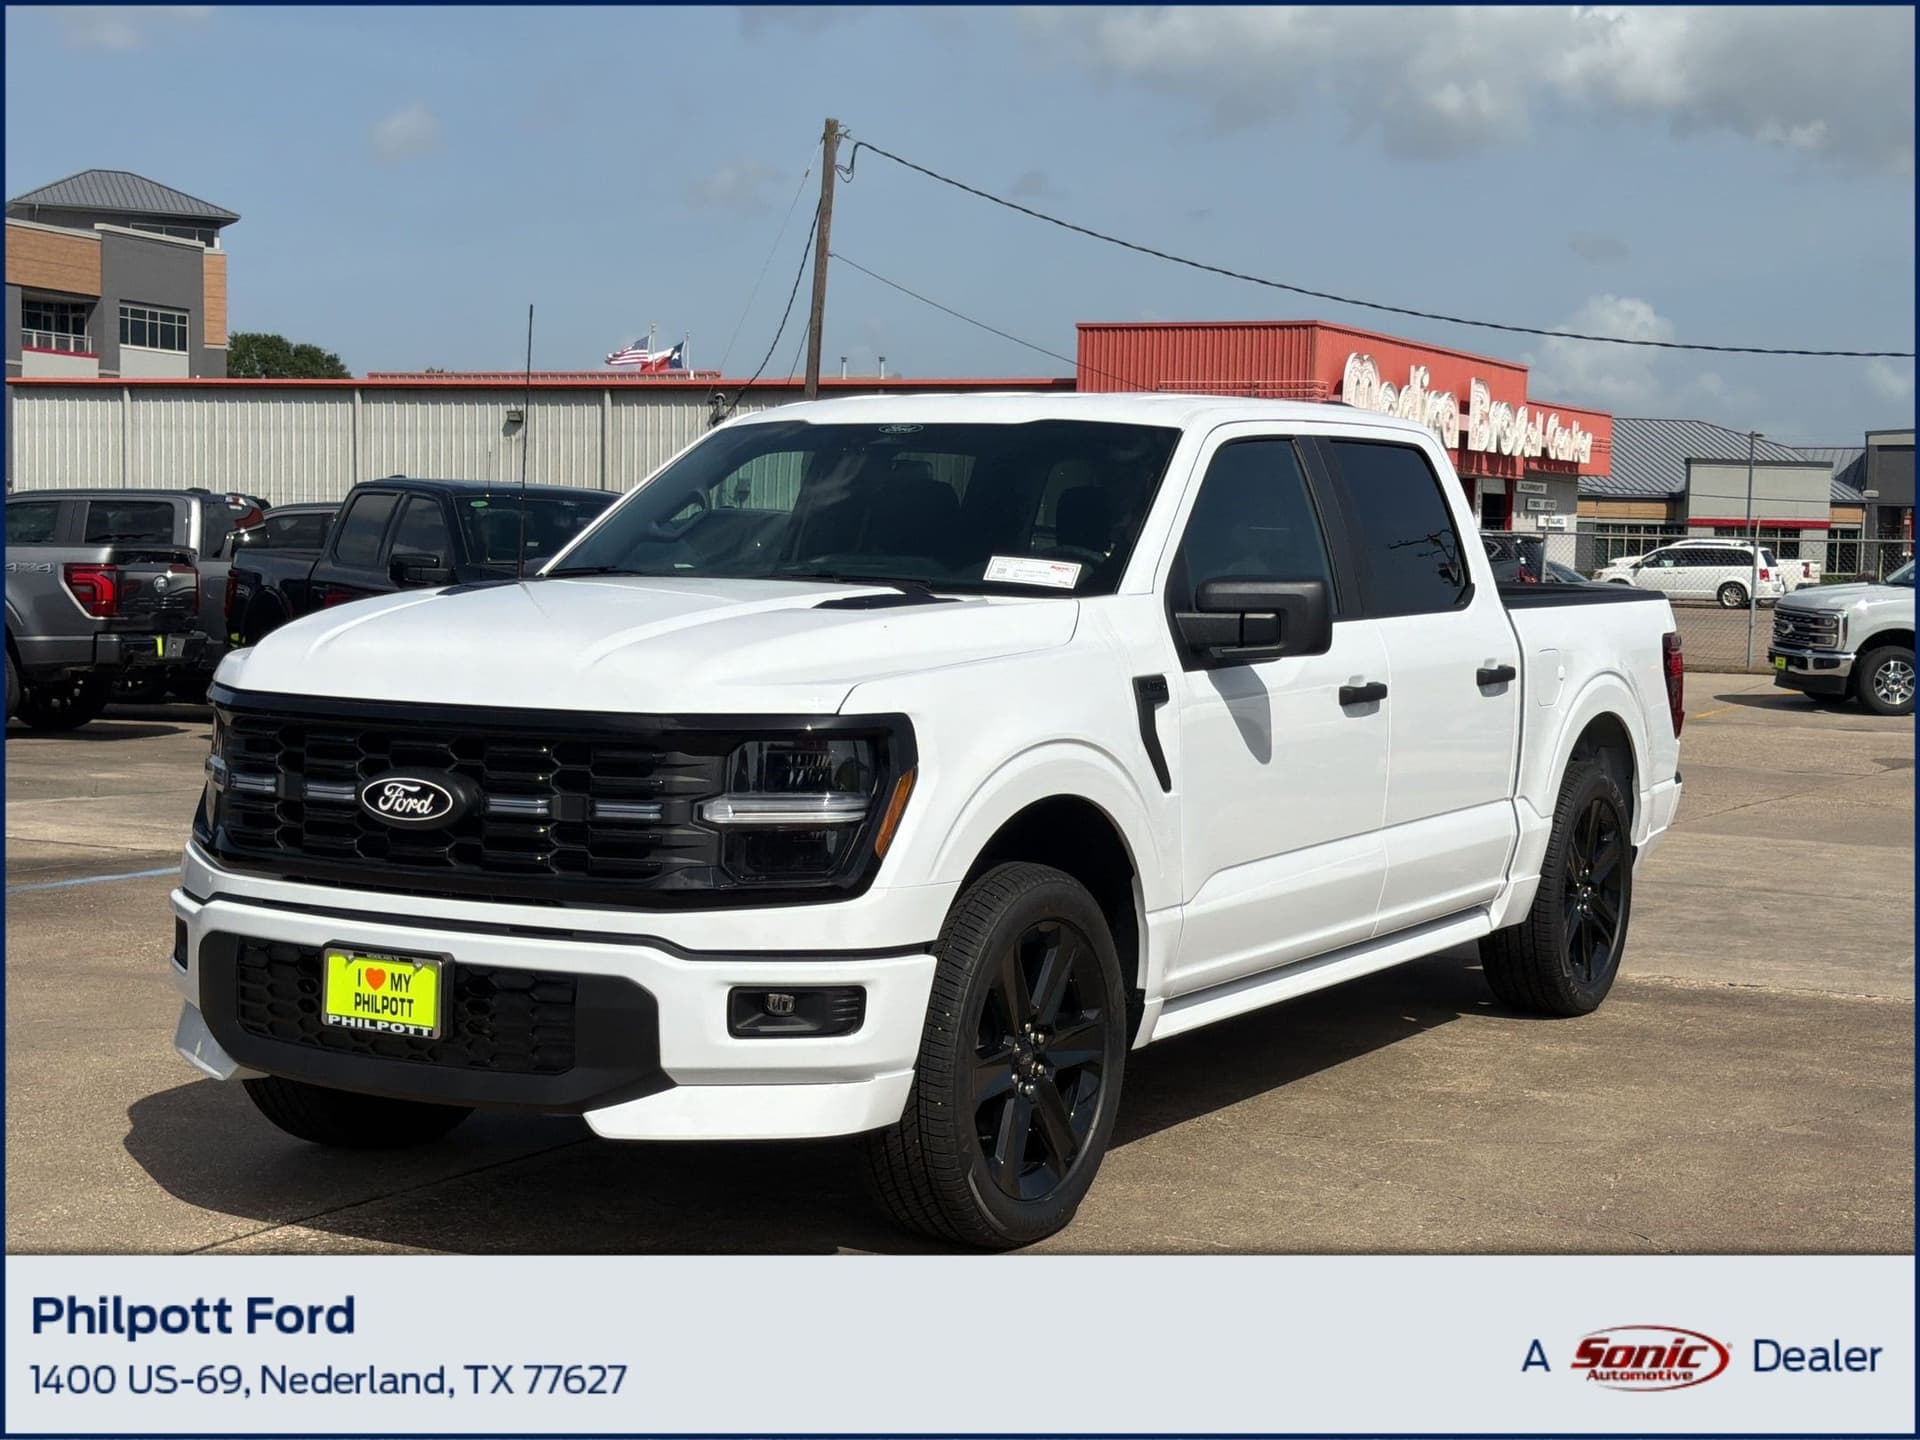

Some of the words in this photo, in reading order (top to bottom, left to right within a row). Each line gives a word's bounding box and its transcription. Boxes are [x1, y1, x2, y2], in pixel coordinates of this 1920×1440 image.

[378, 783, 434, 814] Ford
[357, 968, 362, 987] I
[391, 973, 412, 993] MY
[354, 992, 414, 1018] PHILPOTT
[328, 1015, 433, 1037] PHILPOTT
